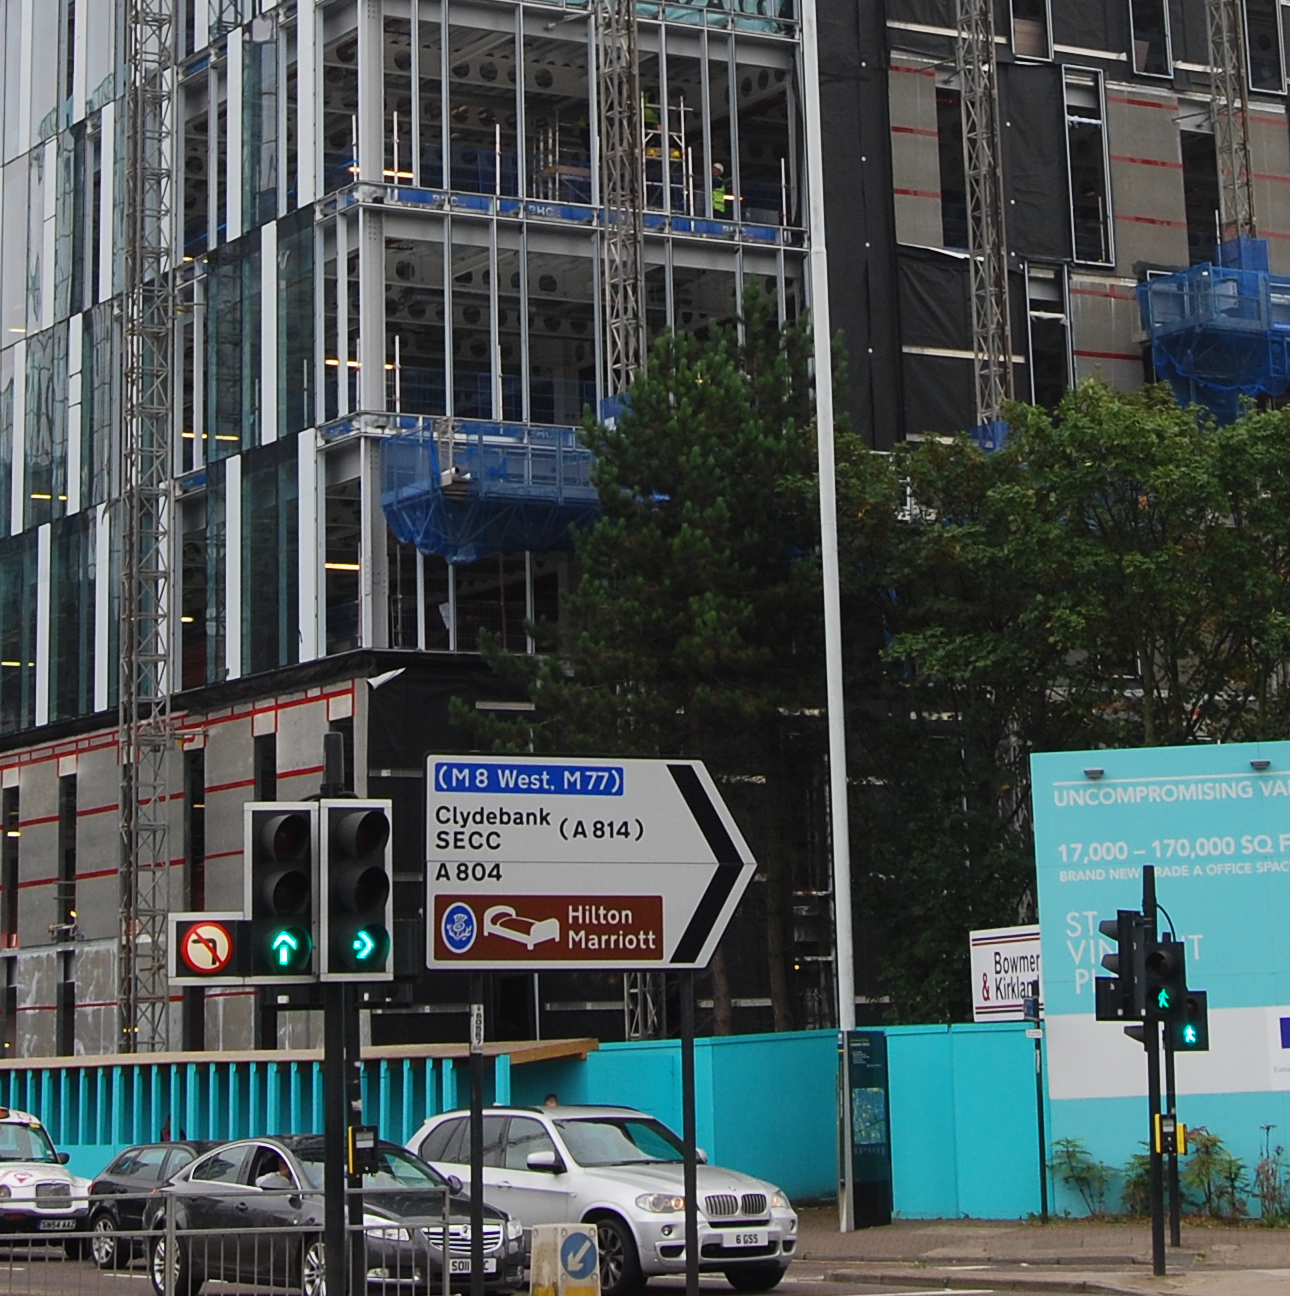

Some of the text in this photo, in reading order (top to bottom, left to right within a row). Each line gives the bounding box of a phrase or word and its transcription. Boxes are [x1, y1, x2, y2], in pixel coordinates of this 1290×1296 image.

[528, 204, 554, 217] BHC
[498, 770, 555, 791] West,
[1054, 779, 1253, 807] UNCOMPROMISING
[435, 806, 551, 828] Clydebank
[435, 831, 501, 850] SECC
[1059, 840, 1128, 864] 17,000
[1152, 836, 1235, 859] 170,000
[1241, 835, 1273, 854] SQ
[1059, 867, 1105, 882] BRAND
[1109, 866, 1140, 880] NEW
[1156, 864, 1189, 878] RADE
[1193, 864, 1203, 877] A
[1206, 862, 1252, 877] OFFICE
[567, 905, 633, 925] Hilton
[1066, 911, 1097, 938] ST
[567, 930, 656, 950] Marriott
[994, 951, 1040, 974] Bowmer
[982, 972, 990, 1002] &
